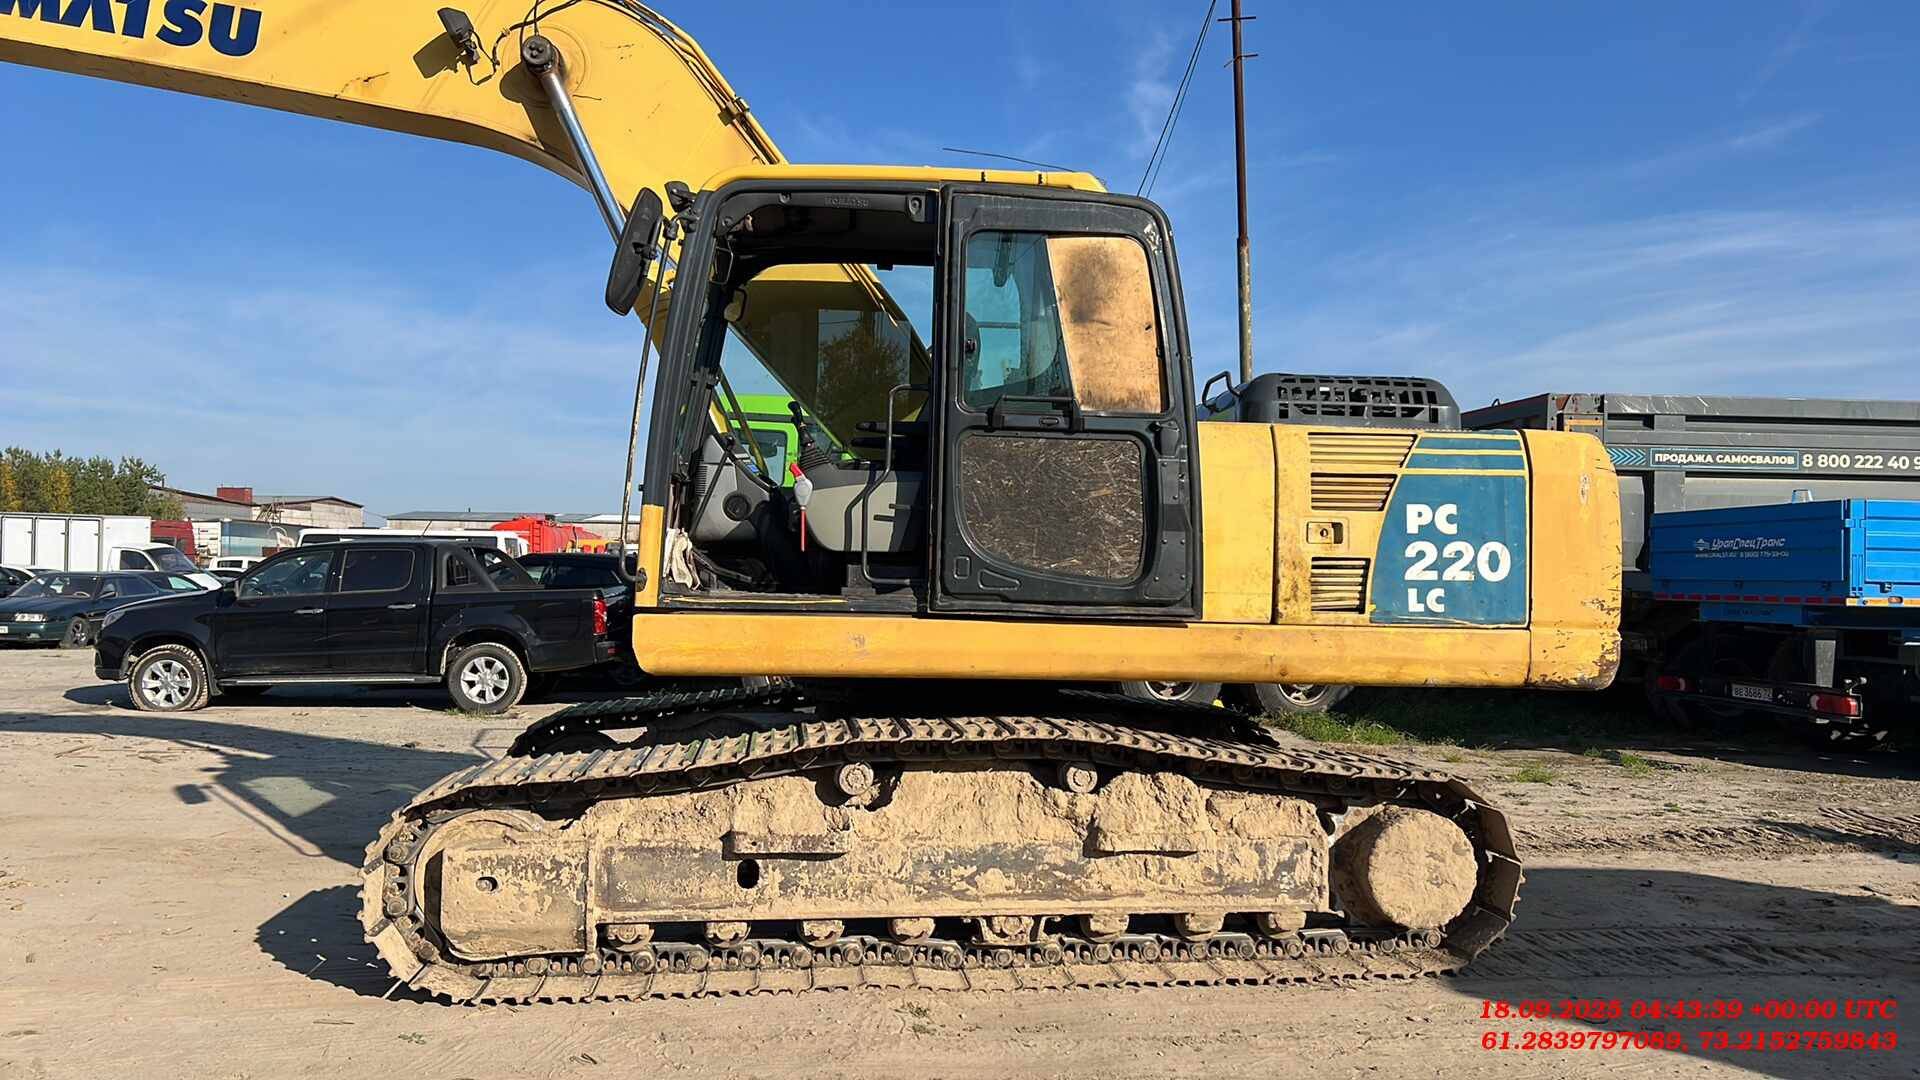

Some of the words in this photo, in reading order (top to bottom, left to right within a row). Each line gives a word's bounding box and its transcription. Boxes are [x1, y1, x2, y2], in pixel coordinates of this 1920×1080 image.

[1654, 453, 1713, 464] ПРОДАЖА
[1716, 455, 1795, 465] САМОСВАЛОВ
[1802, 453, 1813, 468] 8
[1818, 454, 1850, 469] 800
[1854, 455, 1883, 469] 222
[1887, 456, 1910, 470] 40
[1406, 503, 1458, 535] PC
[1404, 540, 1511, 582] 220
[1407, 587, 1445, 613] LC
